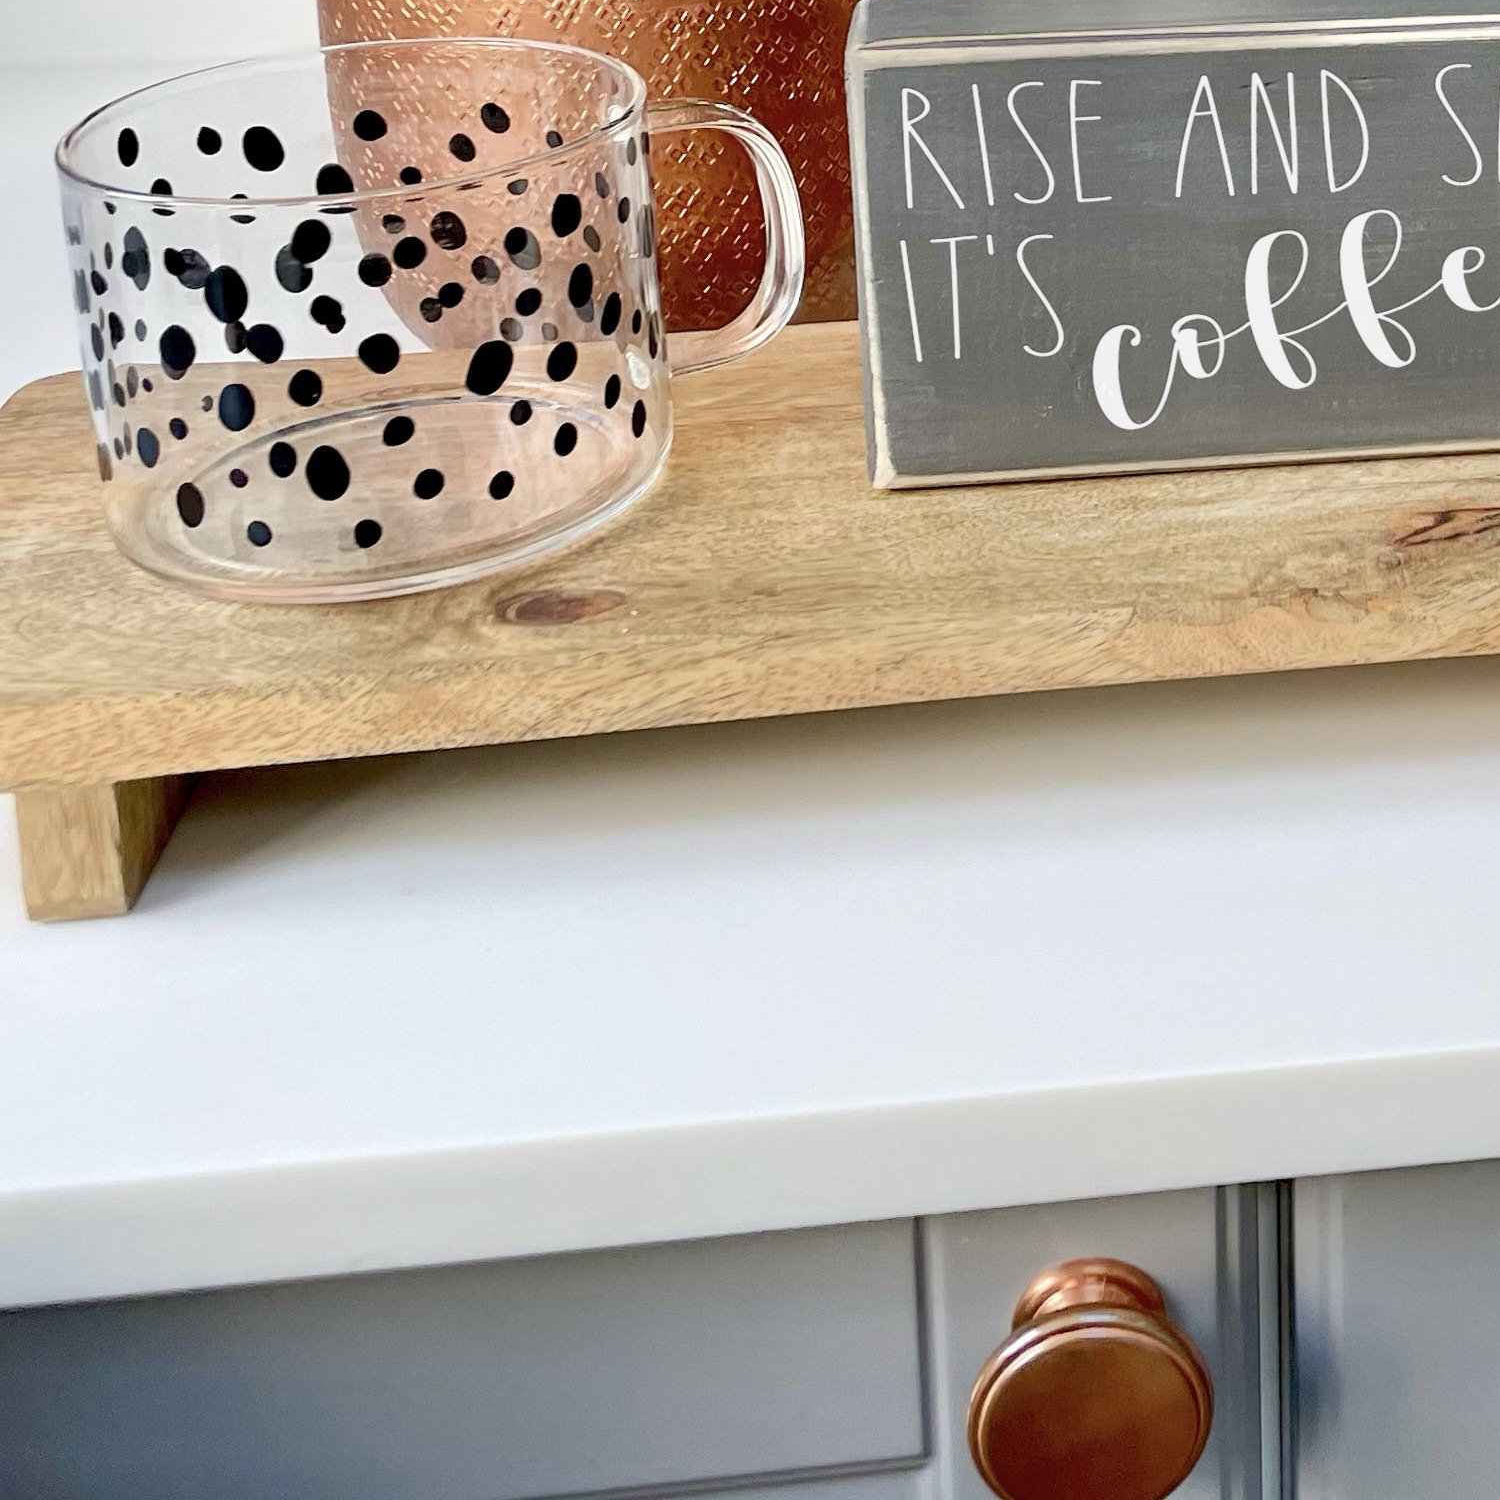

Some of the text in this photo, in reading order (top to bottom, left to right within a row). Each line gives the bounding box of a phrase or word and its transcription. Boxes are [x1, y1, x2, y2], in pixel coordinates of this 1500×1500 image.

[901, 79, 1114, 212] RISE
[1175, 68, 1371, 198] AND
[899, 231, 1066, 363] IT'S
